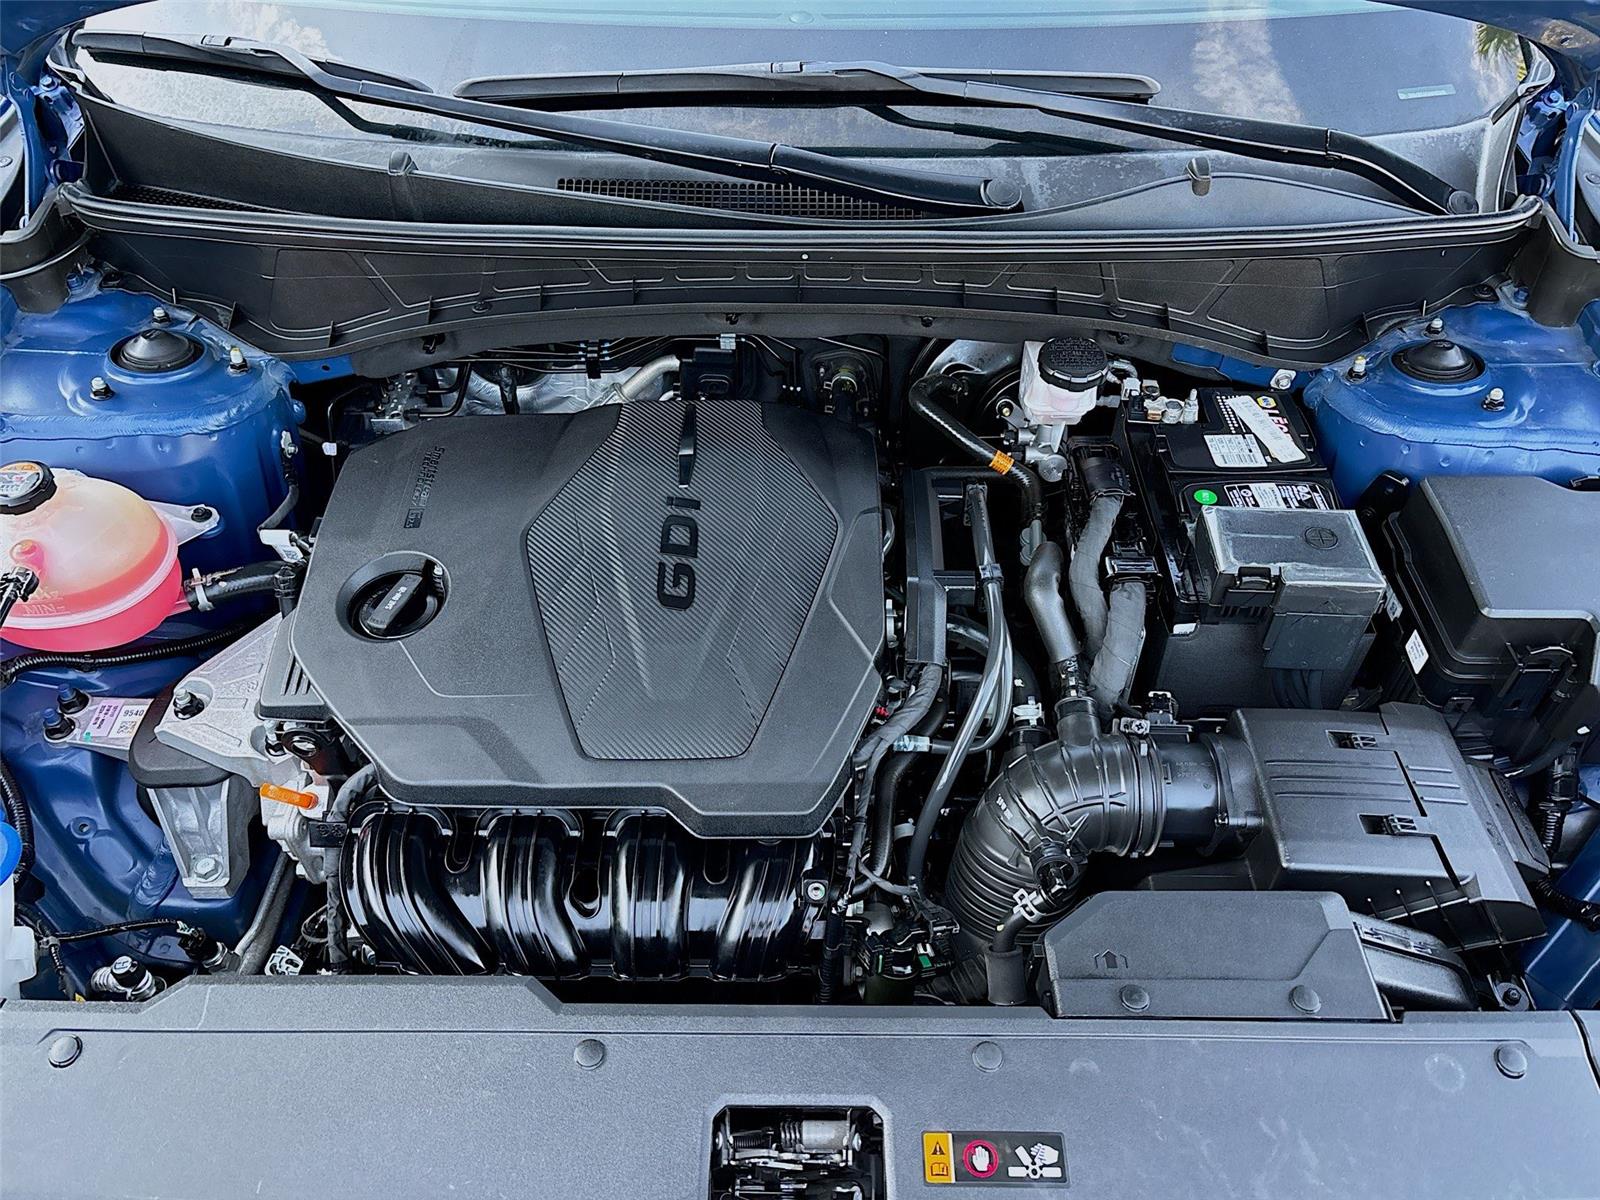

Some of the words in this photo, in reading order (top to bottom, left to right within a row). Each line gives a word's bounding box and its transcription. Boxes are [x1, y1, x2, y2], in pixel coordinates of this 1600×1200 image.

[419, 446, 446, 507] Smartstream
[657, 496, 701, 611] GDi
[123, 709, 145, 717] 9540
